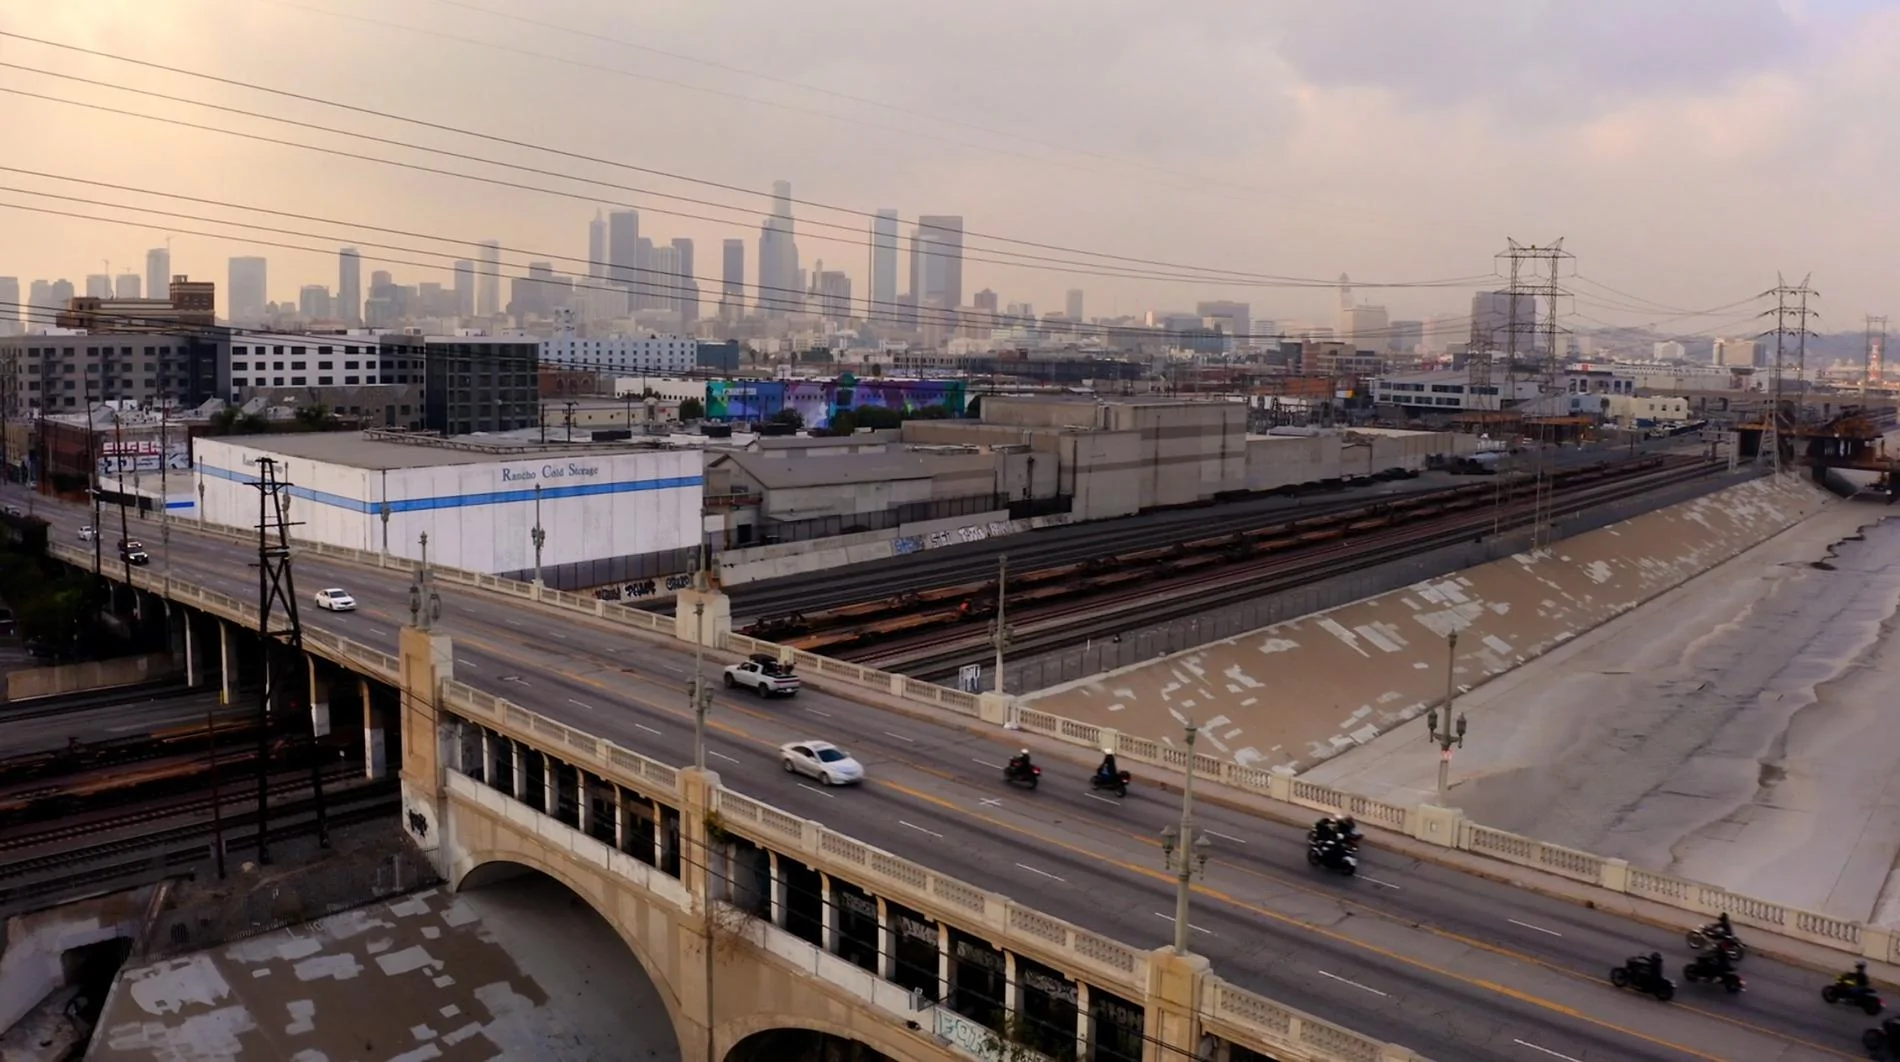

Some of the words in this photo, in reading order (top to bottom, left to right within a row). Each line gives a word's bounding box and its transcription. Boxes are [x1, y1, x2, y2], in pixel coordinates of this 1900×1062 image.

[502, 467, 537, 482] Rancho
[542, 464, 565, 479] Cold
[568, 462, 599, 477] Storage
